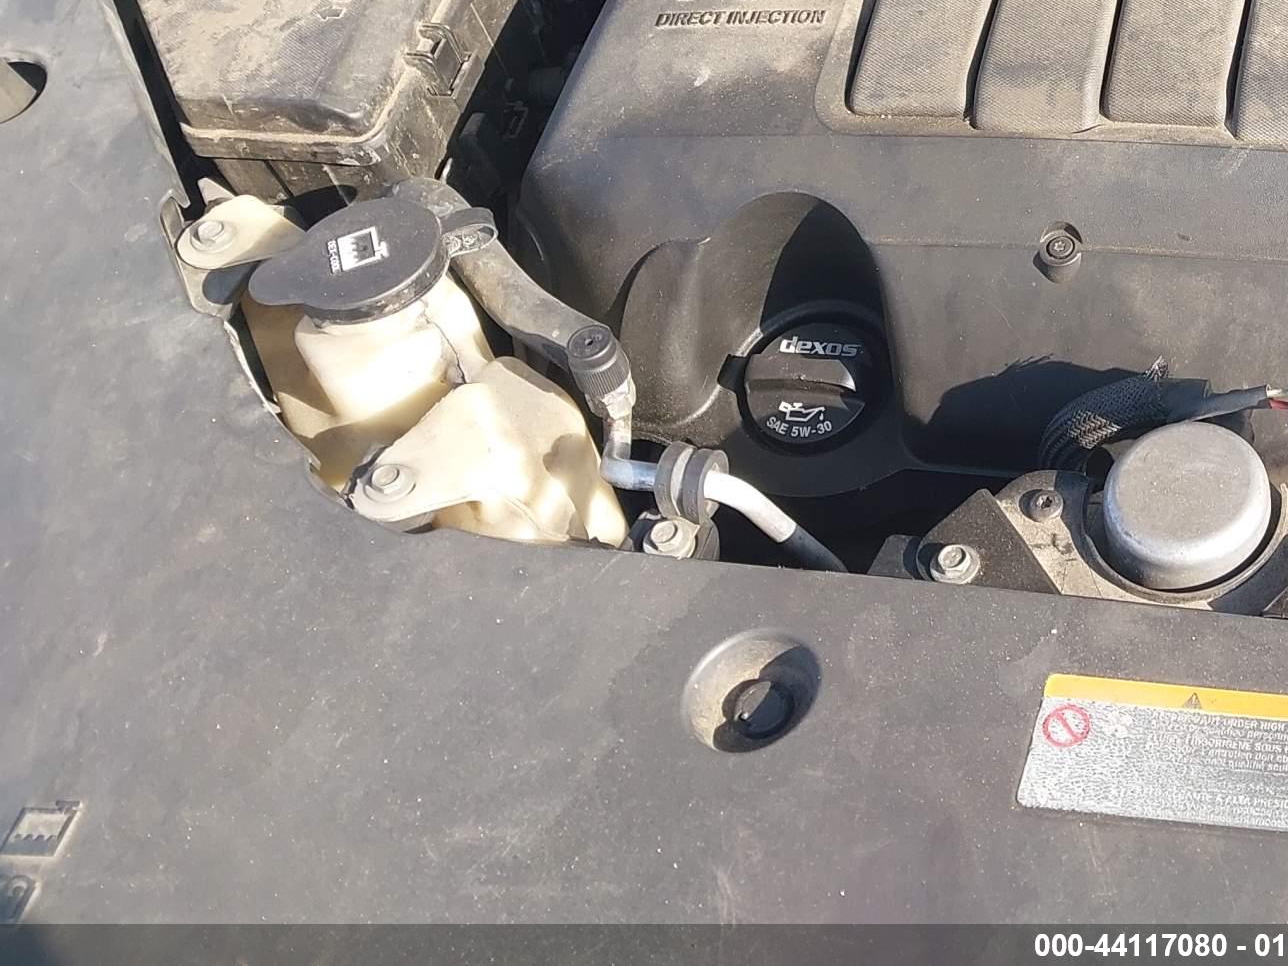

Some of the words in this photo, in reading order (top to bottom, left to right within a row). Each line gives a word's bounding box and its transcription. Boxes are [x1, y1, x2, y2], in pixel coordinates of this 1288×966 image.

[654, 9, 726, 28] DIRECT
[726, 8, 828, 26] INJECTION
[779, 336, 861, 357] dexos
[766, 416, 790, 435] SAE
[790, 420, 832, 438] 5W-30
[1222, 715, 1258, 730] UNDER
[1259, 720, 1285, 731] HIGH
[1254, 741, 1282, 753] SOUS
